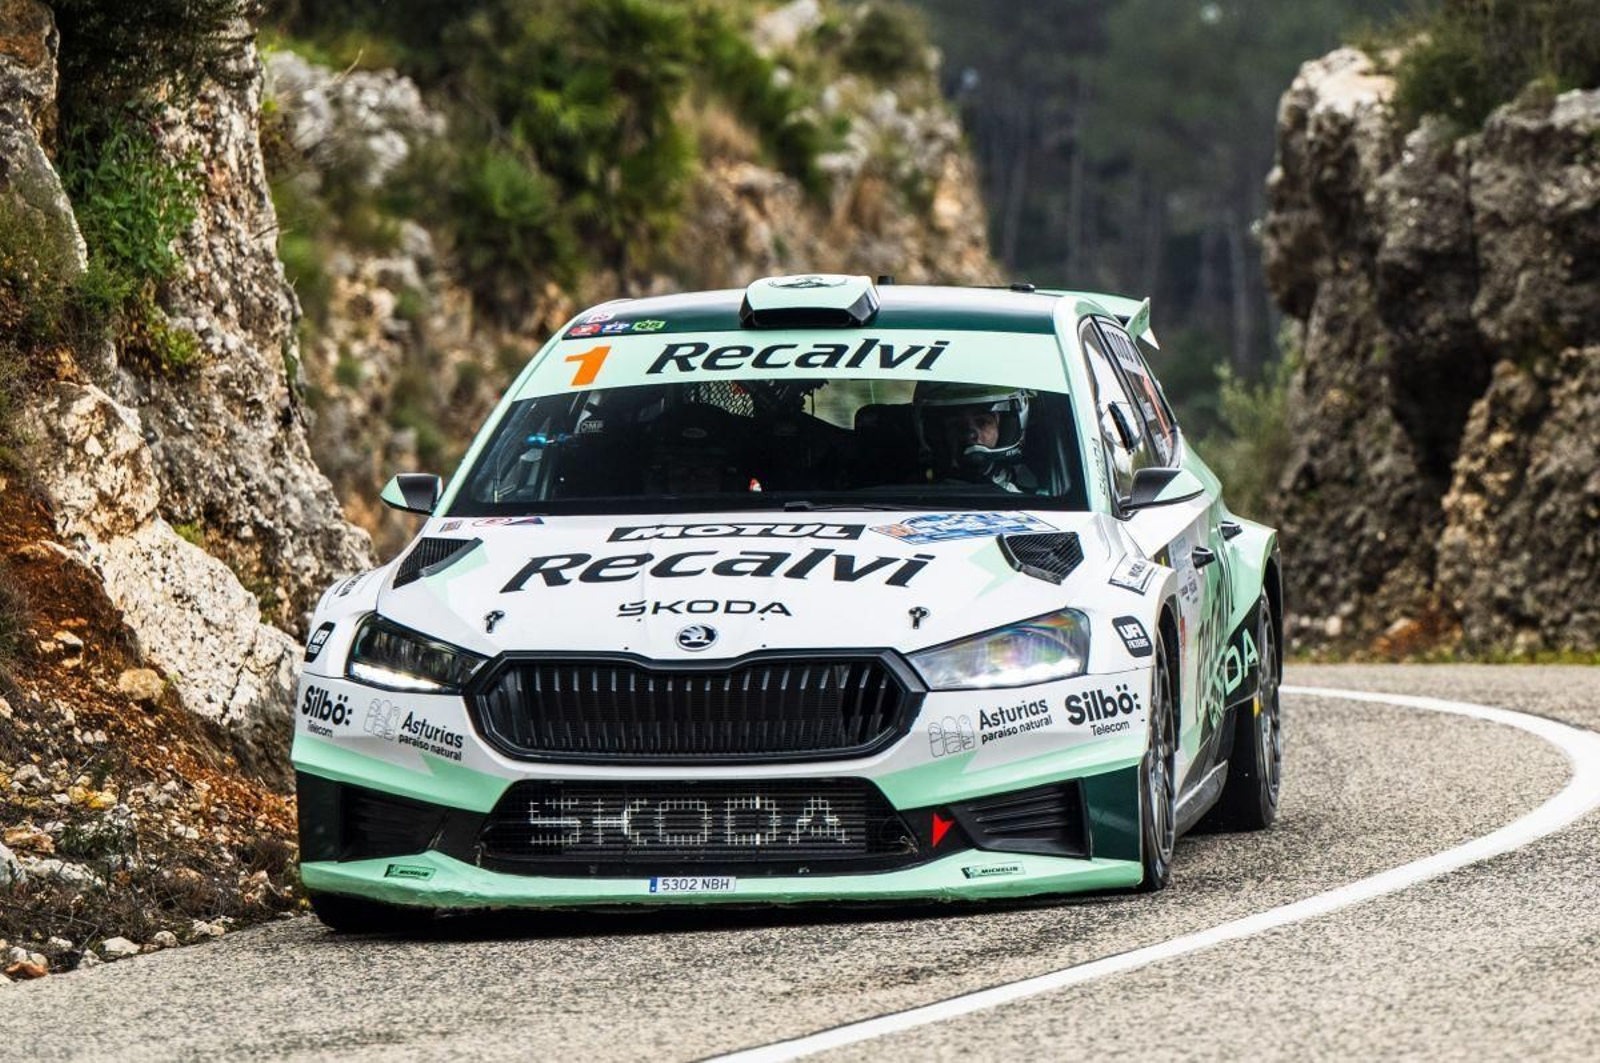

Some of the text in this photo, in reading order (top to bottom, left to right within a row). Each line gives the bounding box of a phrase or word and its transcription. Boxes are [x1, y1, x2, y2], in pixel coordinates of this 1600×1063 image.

[564, 346, 611, 386] 1
[646, 338, 950, 374] Recalvi
[619, 524, 851, 541] MOTUL
[499, 548, 936, 593] Recalvi
[979, 699, 1049, 731] Asturias
[1019, 714, 1053, 734] natural
[308, 719, 333, 738] Telecom
[401, 711, 463, 749] Asturias
[1090, 720, 1131, 737] Telecom
[430, 744, 463, 763] natural
[661, 878, 730, 890] 5302 NBH
